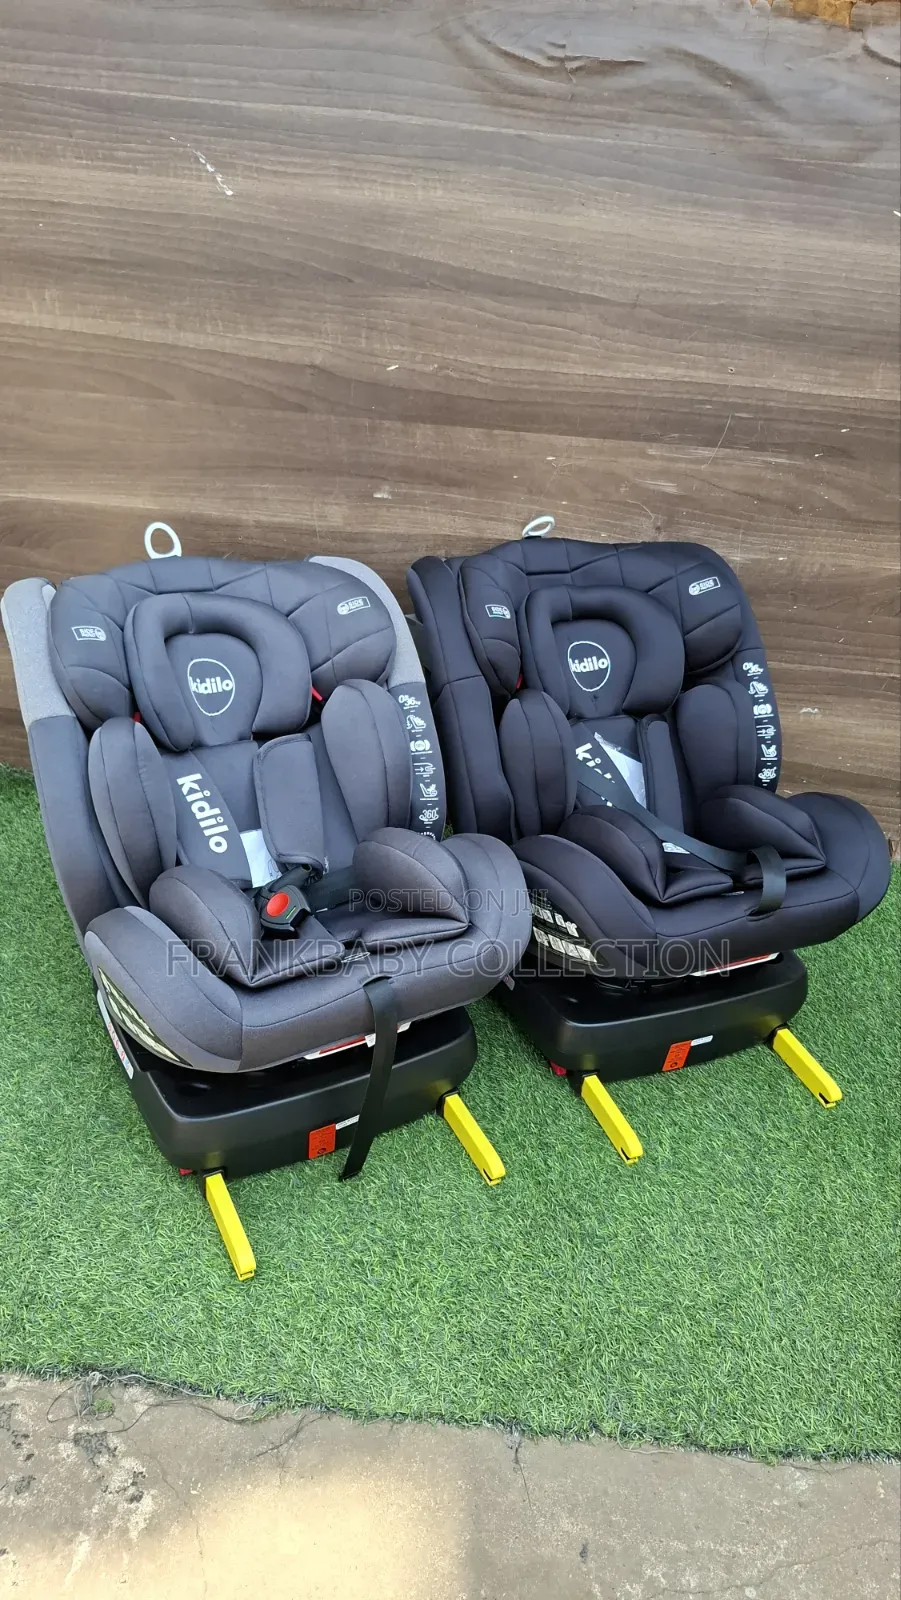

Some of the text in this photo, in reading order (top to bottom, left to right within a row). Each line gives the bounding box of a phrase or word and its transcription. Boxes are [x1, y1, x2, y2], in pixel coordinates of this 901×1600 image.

[568, 656, 608, 672] kidilo
[188, 676, 233, 694] kidilo
[176, 773, 229, 853] kidilo
